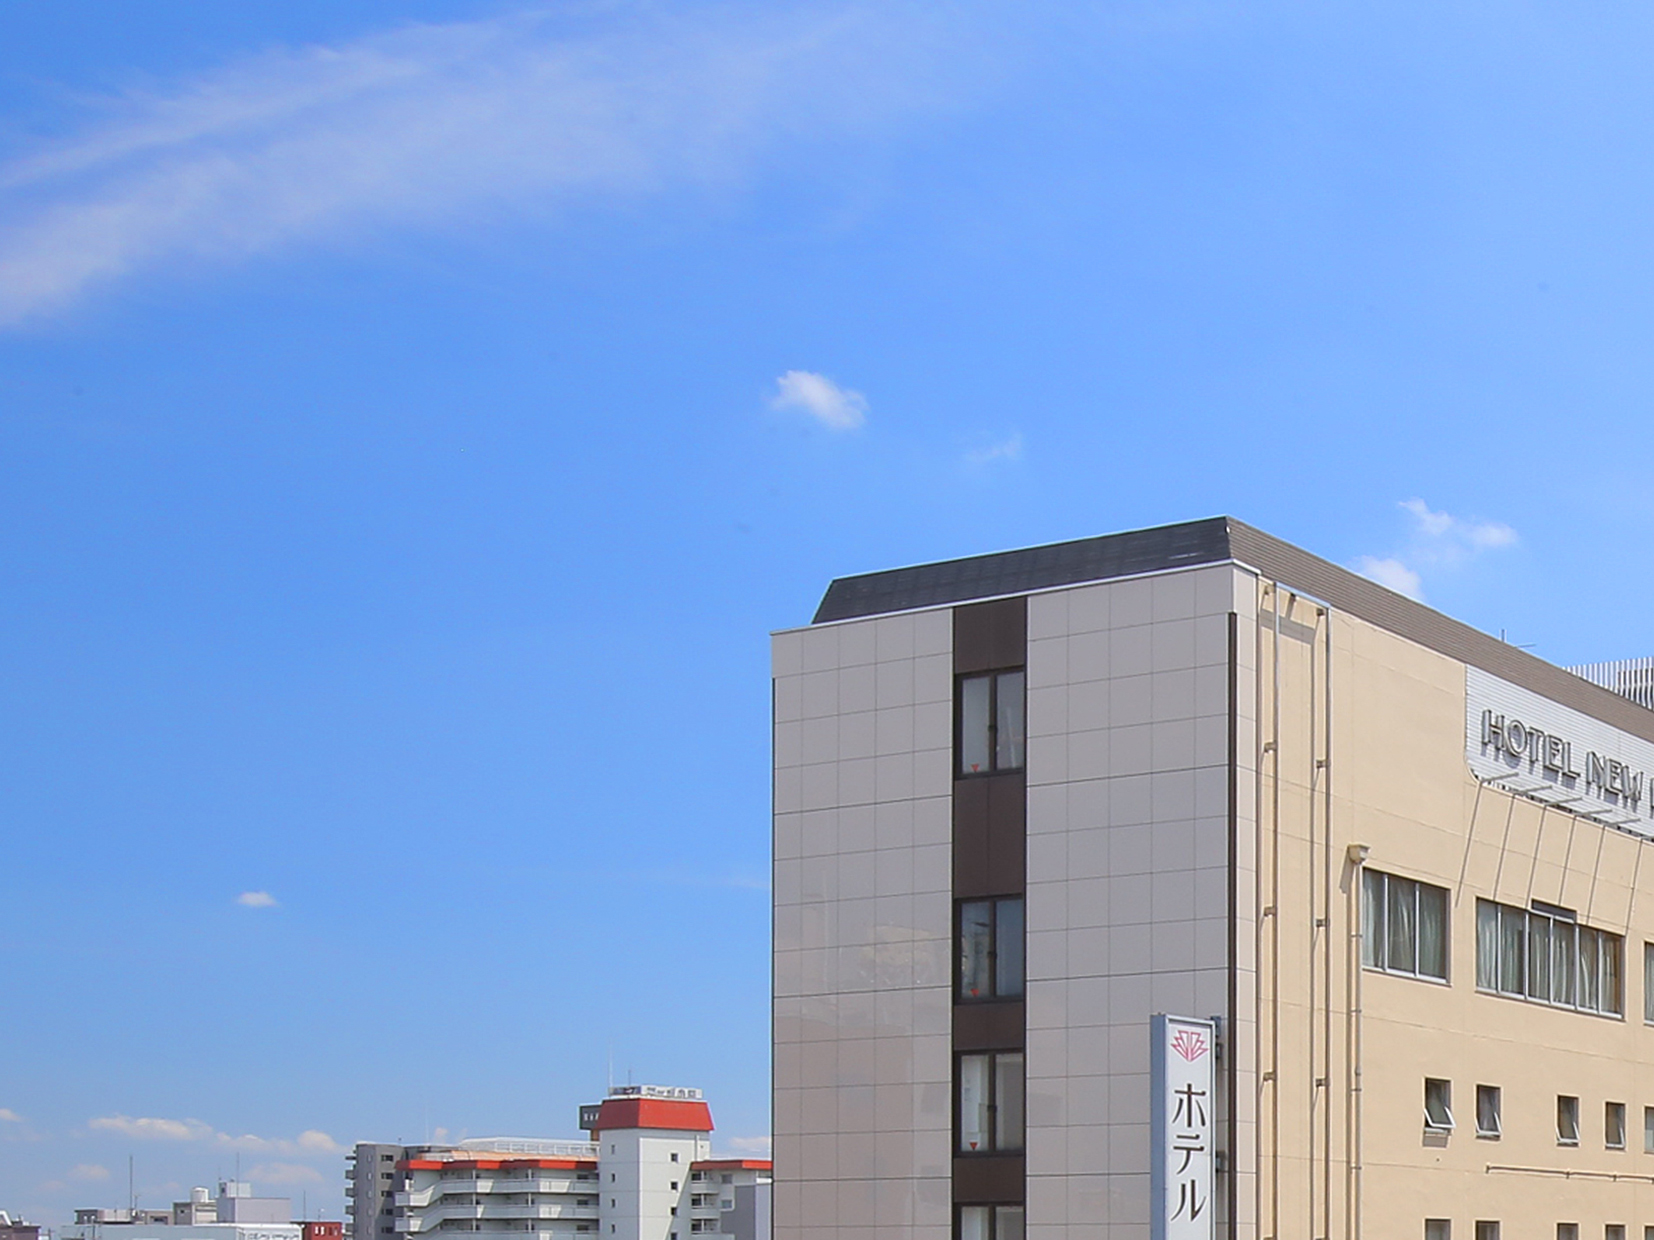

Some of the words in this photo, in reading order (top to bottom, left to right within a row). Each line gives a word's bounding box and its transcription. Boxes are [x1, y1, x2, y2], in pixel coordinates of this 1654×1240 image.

[1481, 709, 1580, 778] HOTEL
[1586, 750, 1643, 801] NEW
[1170, 1082, 1208, 1222] ホテル
